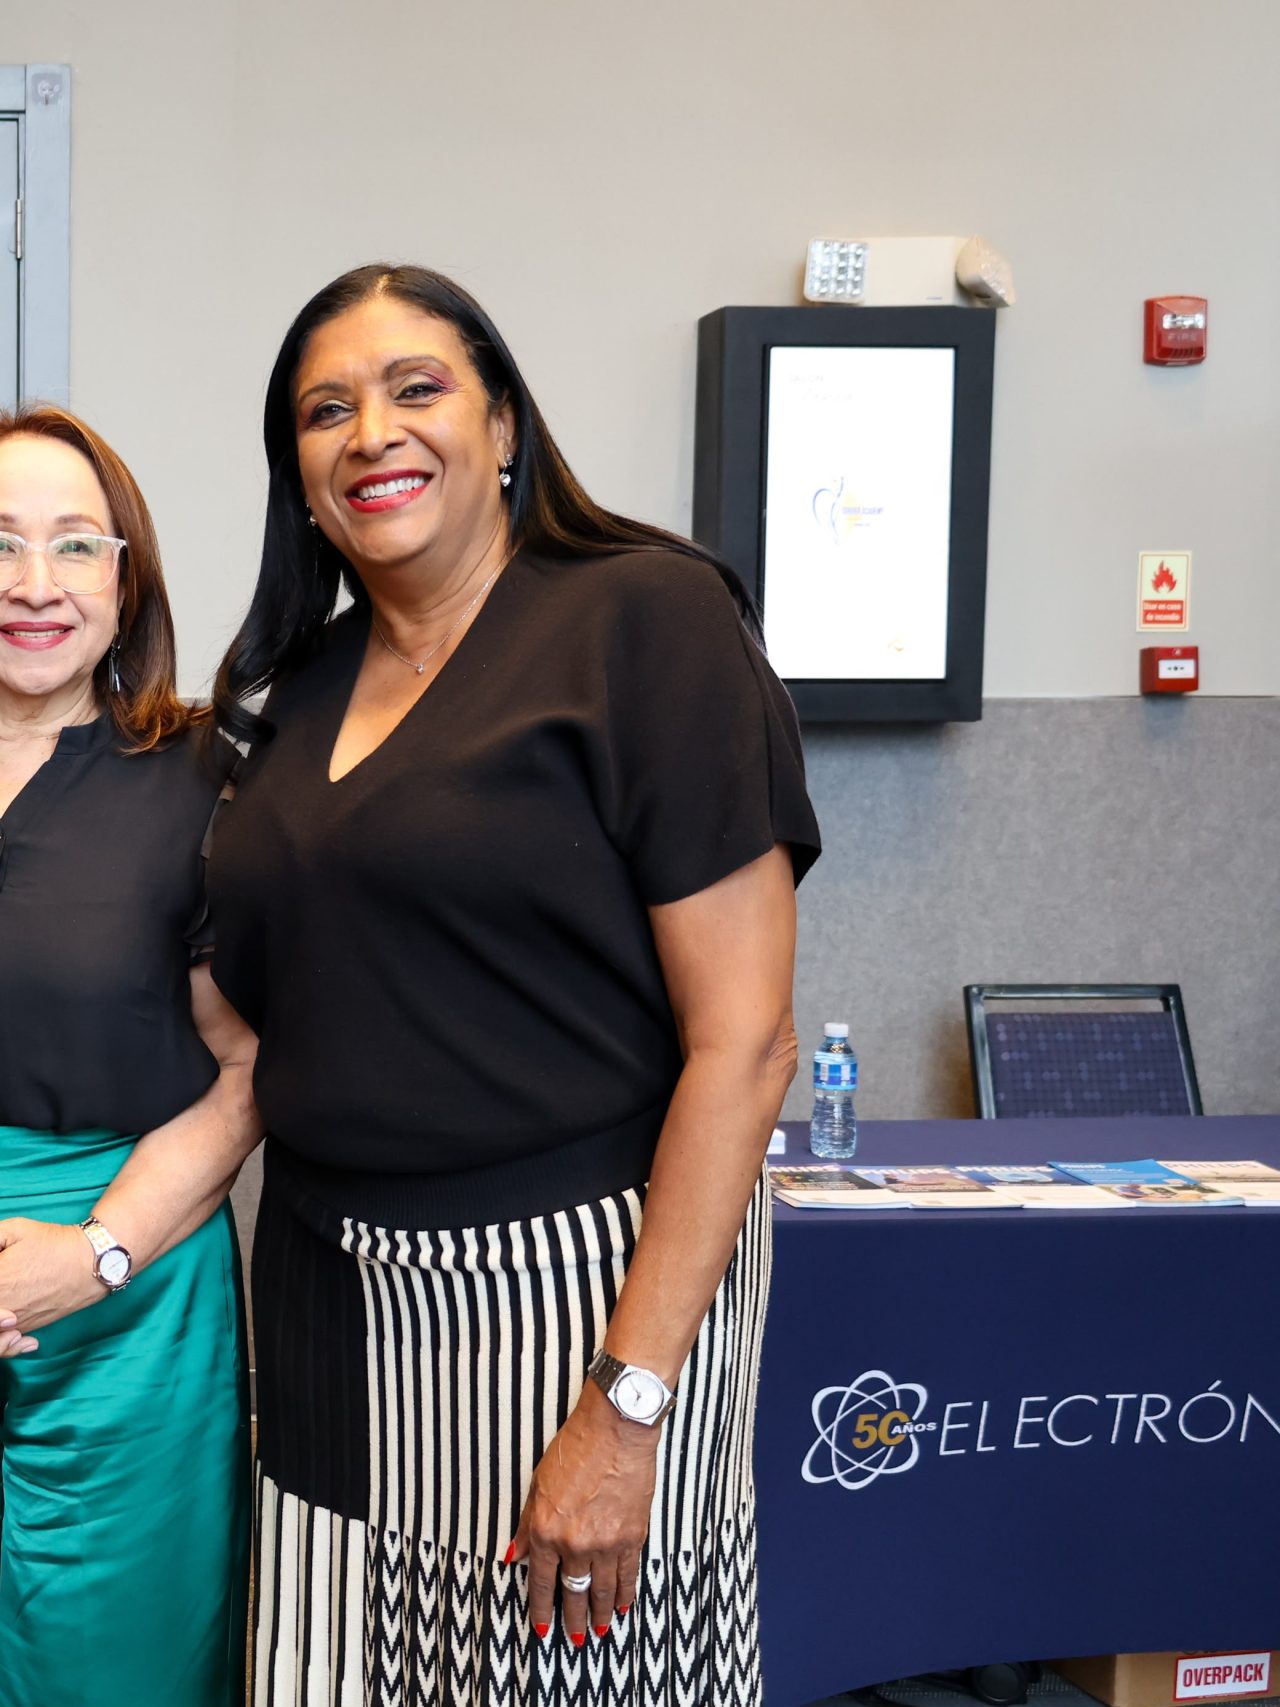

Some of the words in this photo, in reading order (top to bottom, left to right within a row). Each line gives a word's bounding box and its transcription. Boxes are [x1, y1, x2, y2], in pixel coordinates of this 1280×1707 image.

[1167, 332, 1197, 342] FIRE
[852, 1410, 910, 1449] 50
[891, 1422, 937, 1434] AÑOS
[939, 1379, 1280, 1456] ELECTRÓN
[1183, 1662, 1265, 1687] OVERPACK
